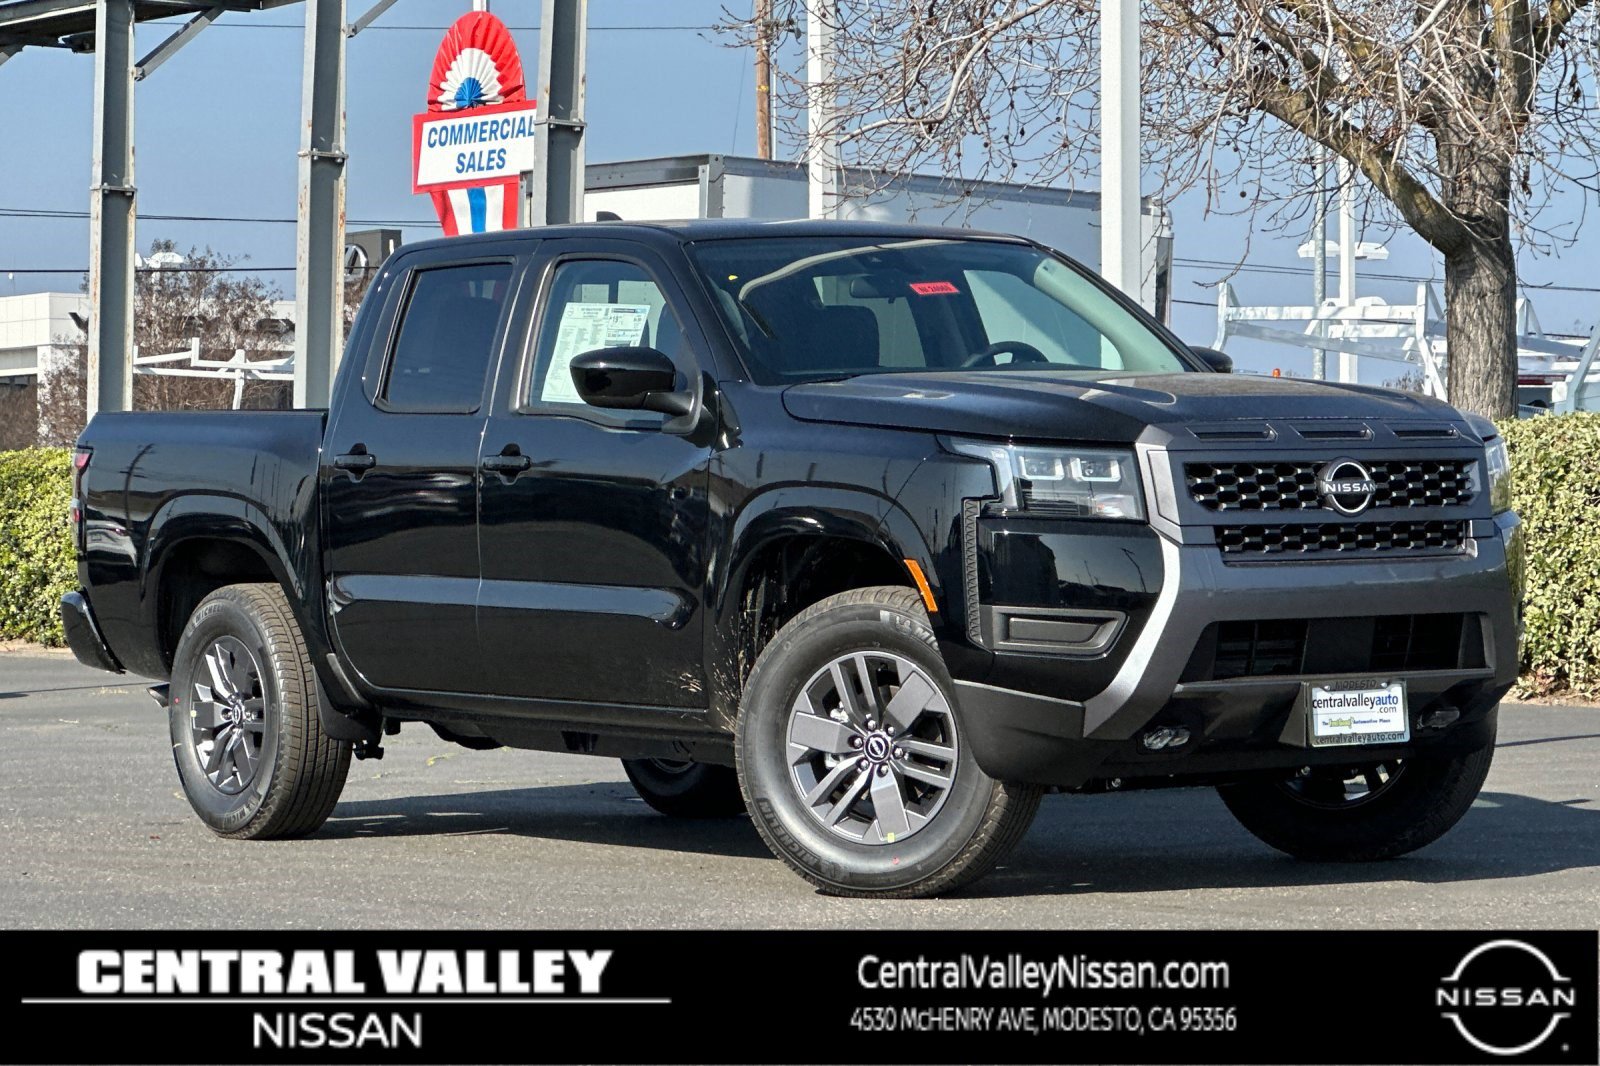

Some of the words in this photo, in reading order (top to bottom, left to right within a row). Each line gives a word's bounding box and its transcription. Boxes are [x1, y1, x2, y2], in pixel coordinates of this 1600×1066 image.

[427, 115, 535, 148] COMMERCIAL
[455, 147, 507, 174] SALES
[1325, 483, 1376, 492] NISSAN
[1335, 679, 1377, 690] MODESTO
[1313, 693, 1399, 710] centralvalleyauto
[1377, 706, 1397, 714] .com
[1315, 732, 1405, 745] centralvalleyauto.com
